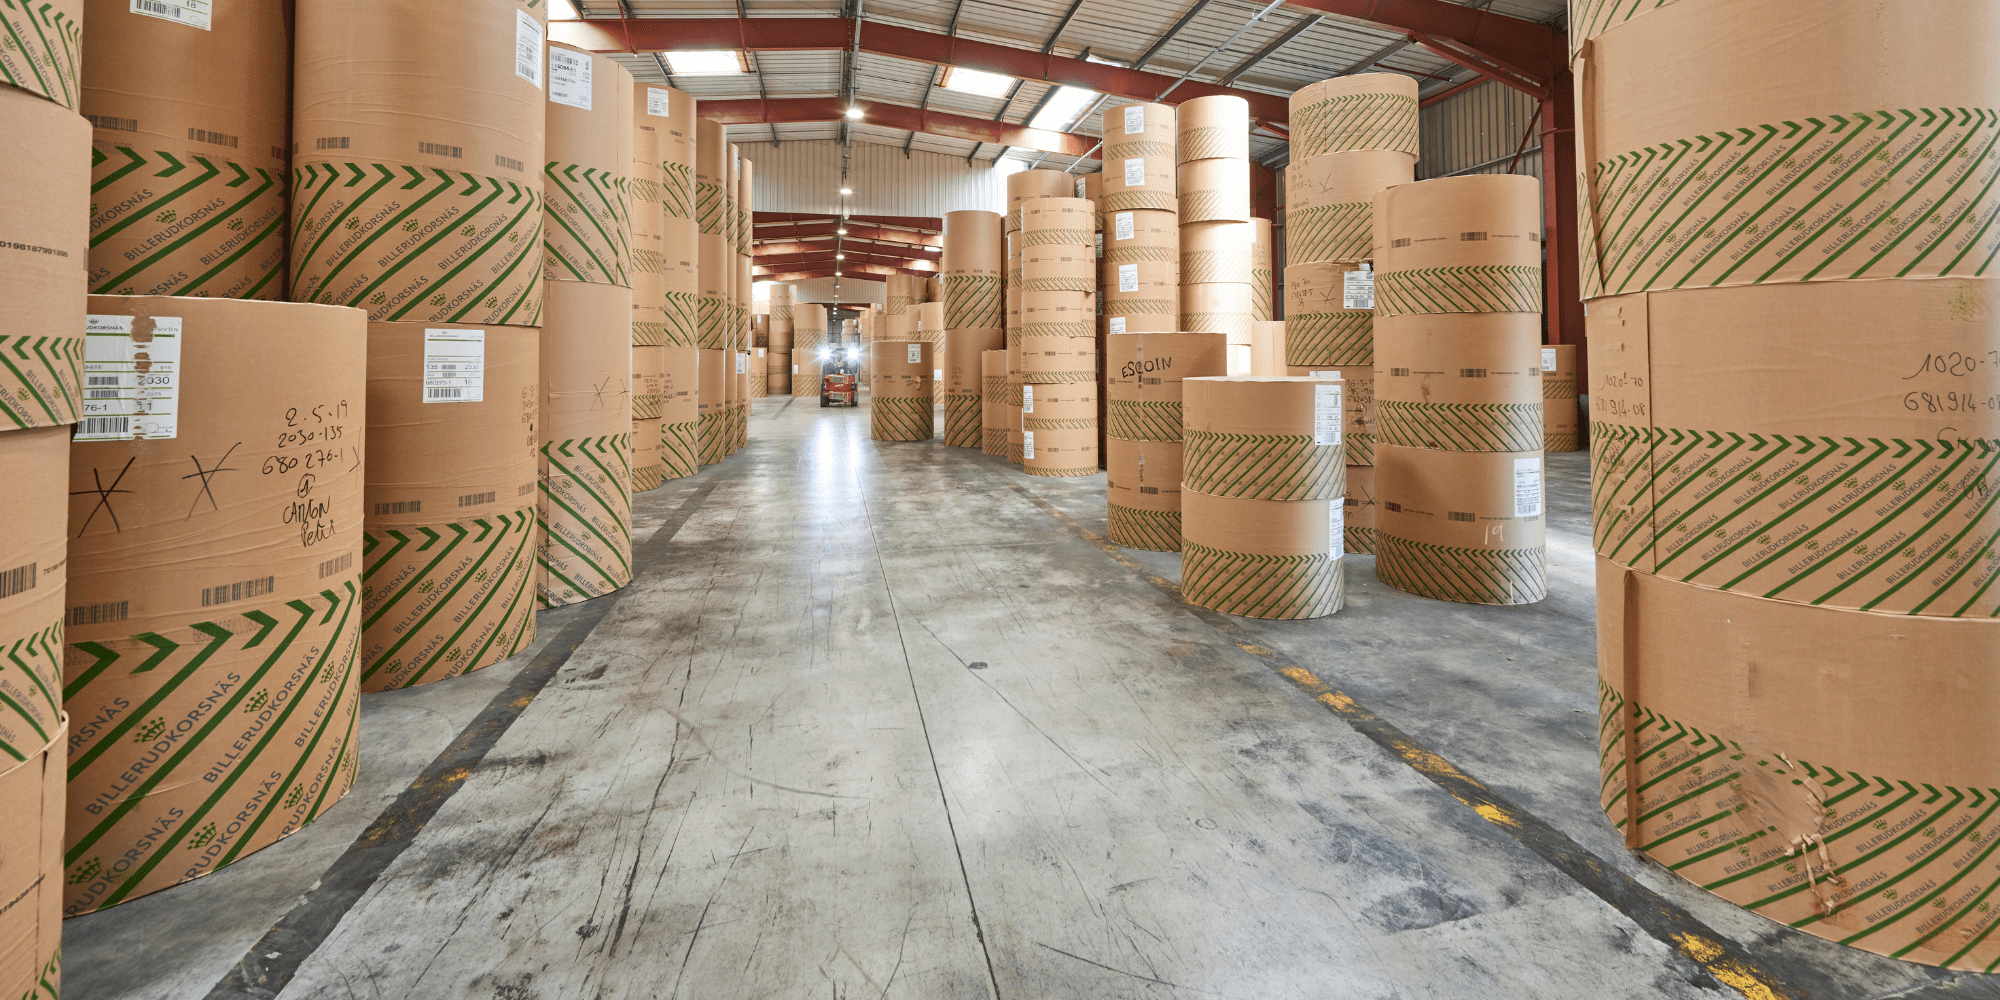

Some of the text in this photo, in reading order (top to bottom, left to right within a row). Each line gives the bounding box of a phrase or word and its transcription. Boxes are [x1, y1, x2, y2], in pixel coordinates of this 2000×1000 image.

[1648, 158, 1700, 212] BILLERUDKORSNÄS
[1682, 151, 1741, 207] BILLERUDKORSNÄS
[1722, 144, 1786, 202] BILLERUDKORSNÄS
[1766, 139, 1834, 196] BILLERUDKORSNÄS
[1812, 135, 1880, 192] BILLERUDKORSNÄS
[1906, 132, 1962, 186] BILLERUDKORSNÄS
[1946, 134, 1992, 184] BILLERUDKORSNÄS
[1600, 173, 1633, 222] BILLERUDKORSNÄS
[1622, 166, 1664, 218] BILLERUDKORSNÄS
[124, 198, 226, 260] BILLERUDKORSNÄS
[200, 207, 278, 266] BILLERUDKORSNÄS
[325, 200, 400, 267] BILLERUDKORSNÄS
[378, 206, 460, 268] BILLERUDKORSNÄS
[438, 213, 508, 270] BILLERUDKORSNÄS
[491, 222, 537, 274] BILLERUDKORSNÄS
[1604, 226, 1639, 274] BILLERUDKORSNÄS
[1626, 221, 1670, 271] BILLERUDKORSNÄS
[1656, 216, 1708, 268] BILLERUDKORSNÄS
[1690, 211, 1750, 264] BILLERUDKORSNÄS
[1730, 206, 1796, 262] BILLERUDKORSNÄS
[1776, 202, 1844, 258] BILLERUDKORSNÄS
[1822, 200, 1890, 255] BILLERUDKORSNÄS
[1915, 198, 1970, 252] BILLERUDKORSNÄS
[1955, 199, 1998, 251] BILLERUDKORSNÄS
[482, 283, 524, 324] RUDKORSNÄS
[1122, 356, 1172, 378] ESCOIN
[574, 465, 616, 507] BILLERUDKORSNÄS
[1659, 453, 1710, 494] BILLERUDKORSNÄS
[1694, 456, 1753, 500] BILLERUDKORSNÄS
[1734, 459, 1800, 505] BILLERUDKORSNÄS
[1779, 462, 1848, 510] BILLERUDKORSNÄS
[1827, 464, 1896, 514] BILLERUDKORSNÄS
[1876, 465, 1942, 516] BILLERUDKORSNÄS
[1922, 465, 1980, 519] BILLERUDKORSNÄS
[554, 522, 602, 562] BILLERUDKORSNÄS
[1485, 524, 1504, 546] 19
[1666, 514, 1718, 554] BILLERUDKORSNÄS
[1701, 520, 1762, 561] BILLERUDKORSNÄS
[1742, 524, 1809, 568] BILLERUDKORSNÄS
[1788, 528, 1858, 574] BILLERUDKORSNÄS
[1836, 531, 1906, 580] BILLERUDKORSNÄS
[1886, 532, 1951, 584] BILLERUDKORSNÄS
[453, 546, 514, 623] BILLERUDKORSNÄS
[1932, 534, 1988, 587] BILLERUDKORSNÄS
[393, 556, 473, 634] BILLERUDKORSNÄS
[294, 624, 358, 748] BILLERUDKORSNÄS
[203, 646, 320, 784] BILLERUDKORSNÄS
[85, 672, 241, 815] BILLERUDKORSNÄS
[1648, 750, 1694, 777] BILLERUDKORSNÄS
[1654, 812, 1702, 837] BILLERUDKORSNÄS
[1686, 828, 1742, 856] BILLERUDKORSNÄS
[1856, 809, 1927, 853] BILLERUDKORSNÄS
[1906, 814, 1972, 863] BILLERUDKORSNÄS
[1866, 880, 1936, 924] BILLERUDKORSNÄS
[1915, 885, 1982, 934] BILLERUDKORSNÄS
